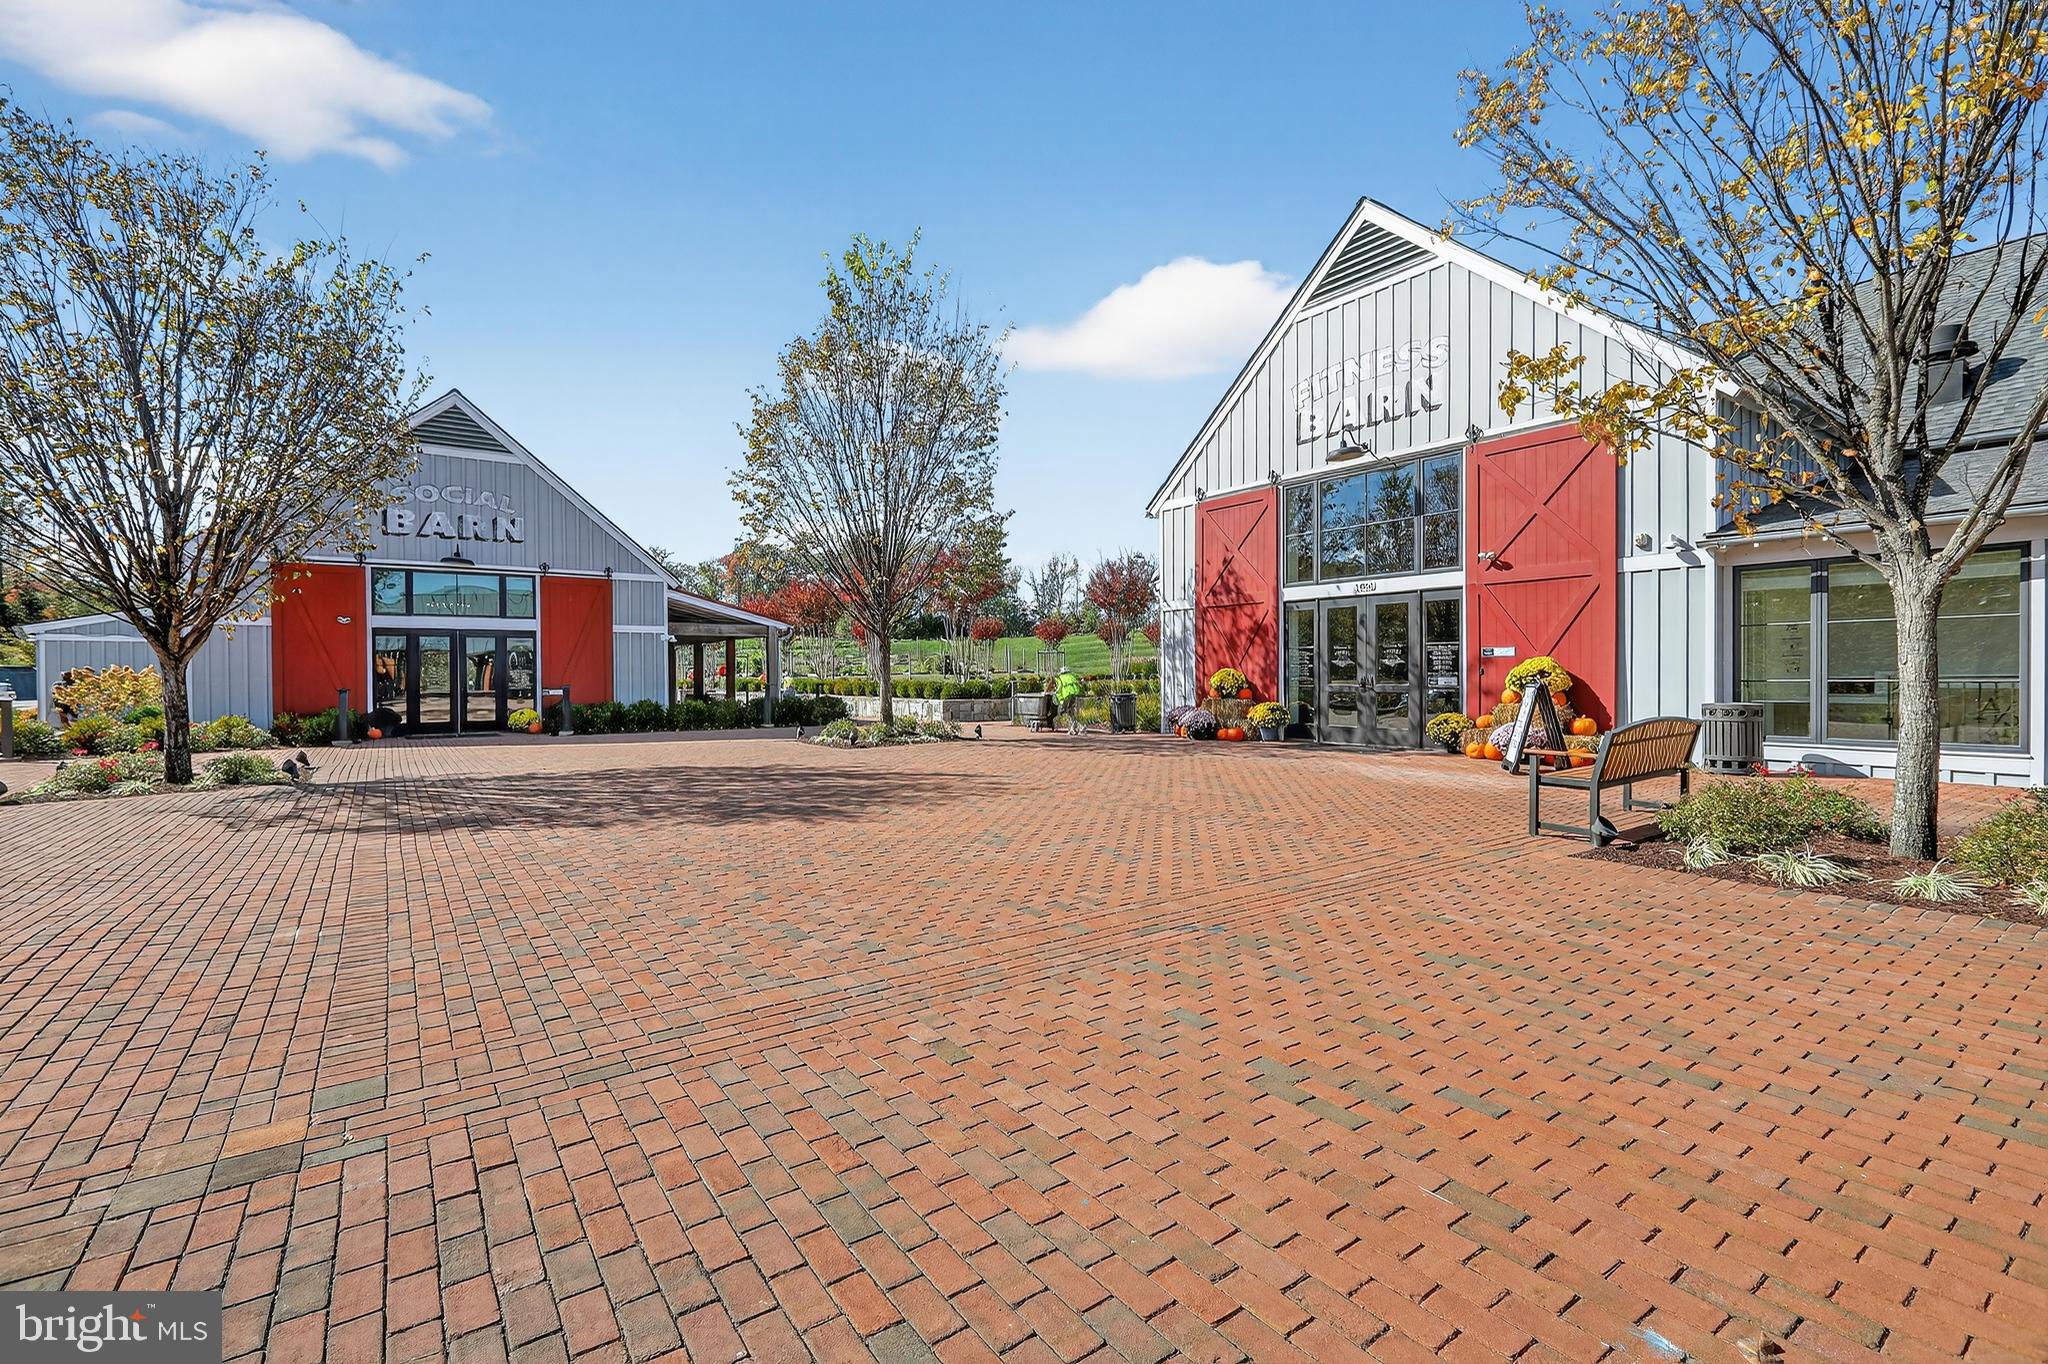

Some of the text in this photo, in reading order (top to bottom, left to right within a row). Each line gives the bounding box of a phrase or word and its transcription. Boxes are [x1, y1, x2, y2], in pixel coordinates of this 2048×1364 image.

[1291, 335, 1449, 412] FITNESS
[1297, 370, 1443, 445] BARN
[382, 505, 525, 543] BARN
[390, 484, 516, 514] SOCIAL
